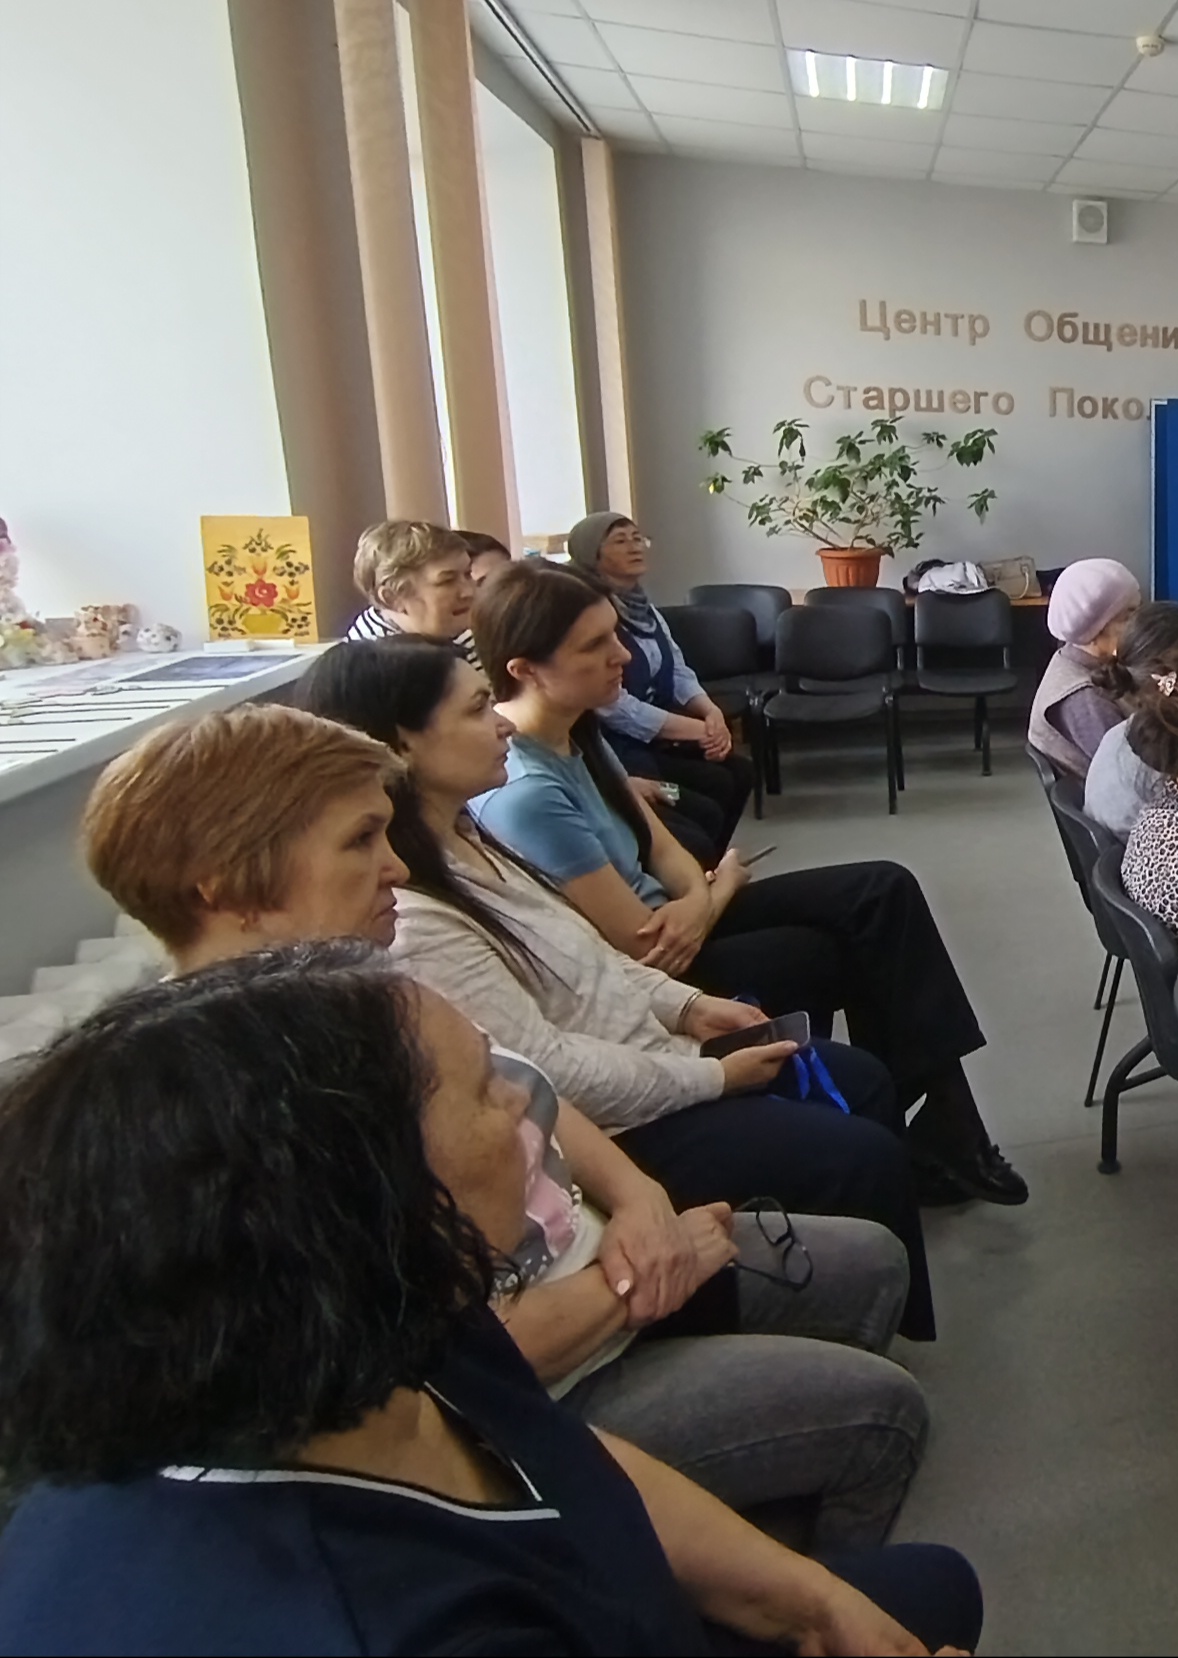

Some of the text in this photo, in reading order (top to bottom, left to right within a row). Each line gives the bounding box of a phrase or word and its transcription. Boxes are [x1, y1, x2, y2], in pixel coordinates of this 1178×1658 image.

[858, 299, 990, 346] Центр
[803, 375, 1151, 421] Старшего Поко
